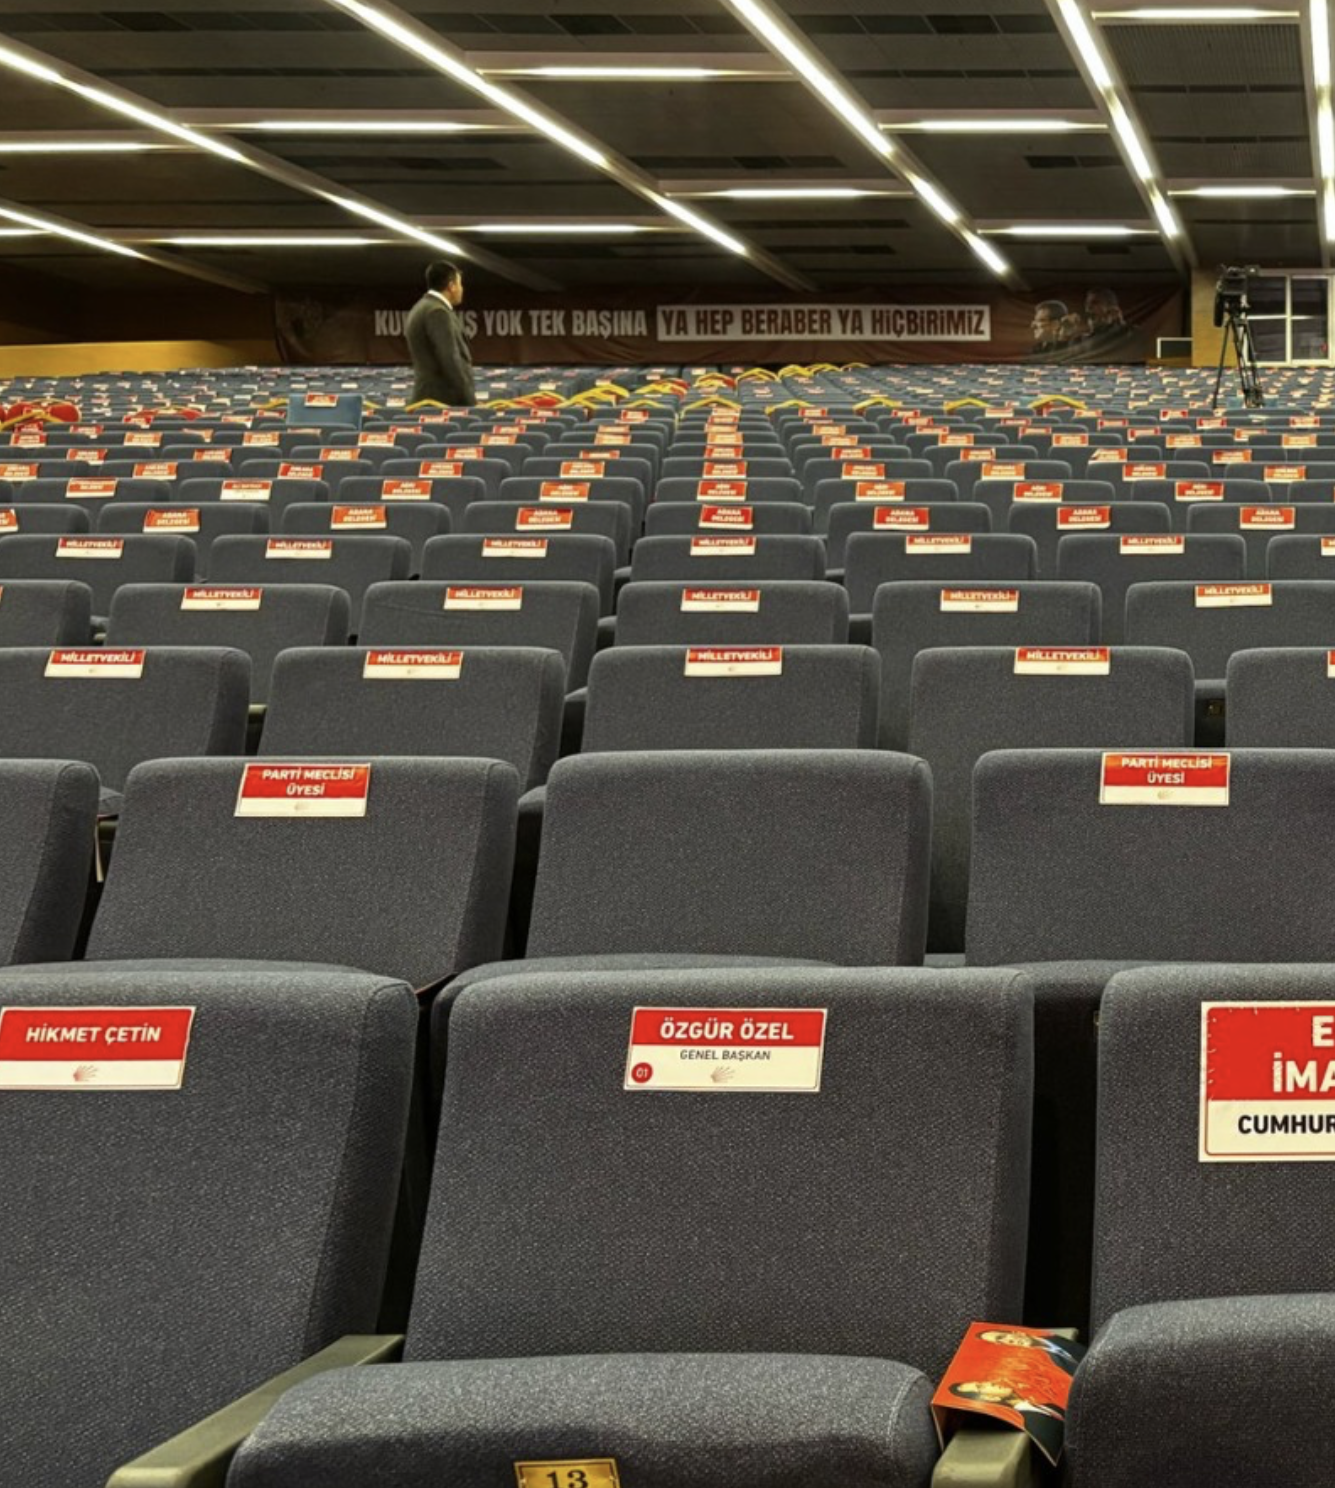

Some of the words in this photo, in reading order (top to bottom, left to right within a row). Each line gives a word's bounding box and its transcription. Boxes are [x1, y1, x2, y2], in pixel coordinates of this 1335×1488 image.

[484, 310, 524, 336] YOK
[528, 310, 566, 336] TEK
[572, 310, 648, 339] BAŞINA
[661, 309, 688, 335] YA
[695, 309, 734, 335] HEP
[741, 309, 832, 335] BERABER
[838, 309, 864, 335] YA
[60, 652, 135, 663] MİLLETVEKİLİ
[377, 652, 452, 664] MİLLETVEKİLİ
[698, 650, 773, 661] MİLLETVEKİLİ
[1027, 649, 1100, 660] MİLLETVEKİLİ
[1122, 756, 1160, 768] PARTİ
[1162, 756, 1212, 768] MECLİSİ
[262, 768, 301, 780] PARTİ
[304, 768, 354, 780] MECLİSİ
[1147, 771, 1185, 784] ÜYESİ
[286, 783, 325, 796] ÜYESİ
[26, 1023, 101, 1043] HİKMET
[105, 1023, 161, 1045] ÇETİN
[660, 1017, 734, 1039] ÖZGÜR
[740, 1017, 794, 1040] ÖZEL
[680, 1050, 718, 1060] GENEL
[722, 1050, 771, 1062] BAŞKAN
[546, 1469, 589, 1488] 13
